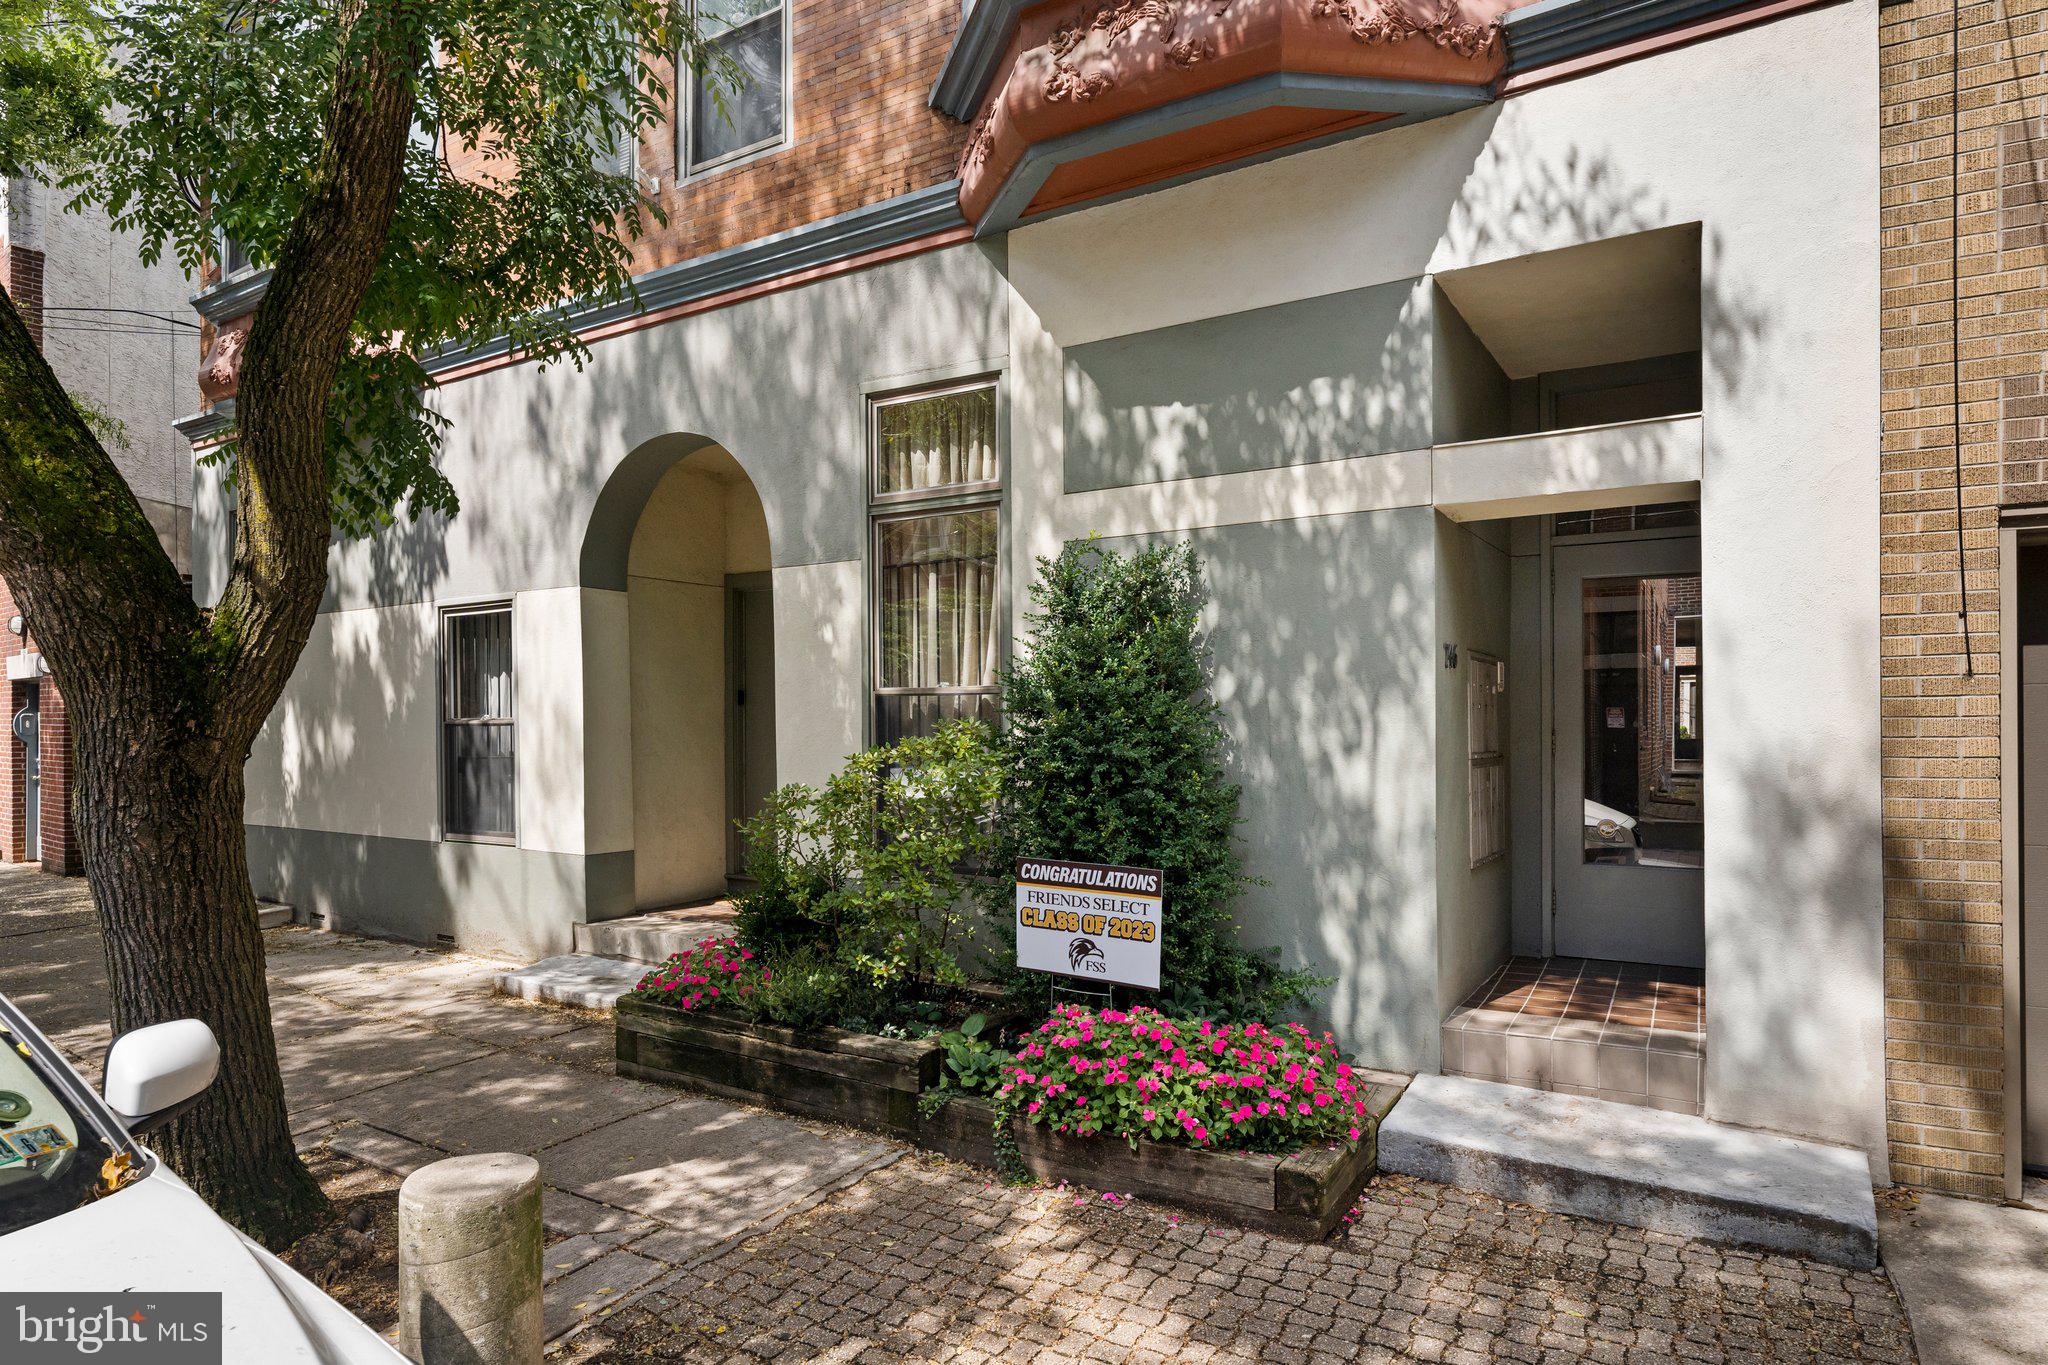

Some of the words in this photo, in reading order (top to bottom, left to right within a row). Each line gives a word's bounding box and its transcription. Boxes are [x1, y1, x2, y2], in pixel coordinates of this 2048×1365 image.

[1021, 863, 1158, 892] CONGRATULATIONS
[1027, 890, 1090, 909] FRIENDS
[1093, 896, 1150, 916] SELECT
[1020, 906, 1079, 933] CLASS
[1082, 914, 1107, 936] OF
[1108, 916, 1156, 943] 2023
[1086, 960, 1107, 974] FSS
